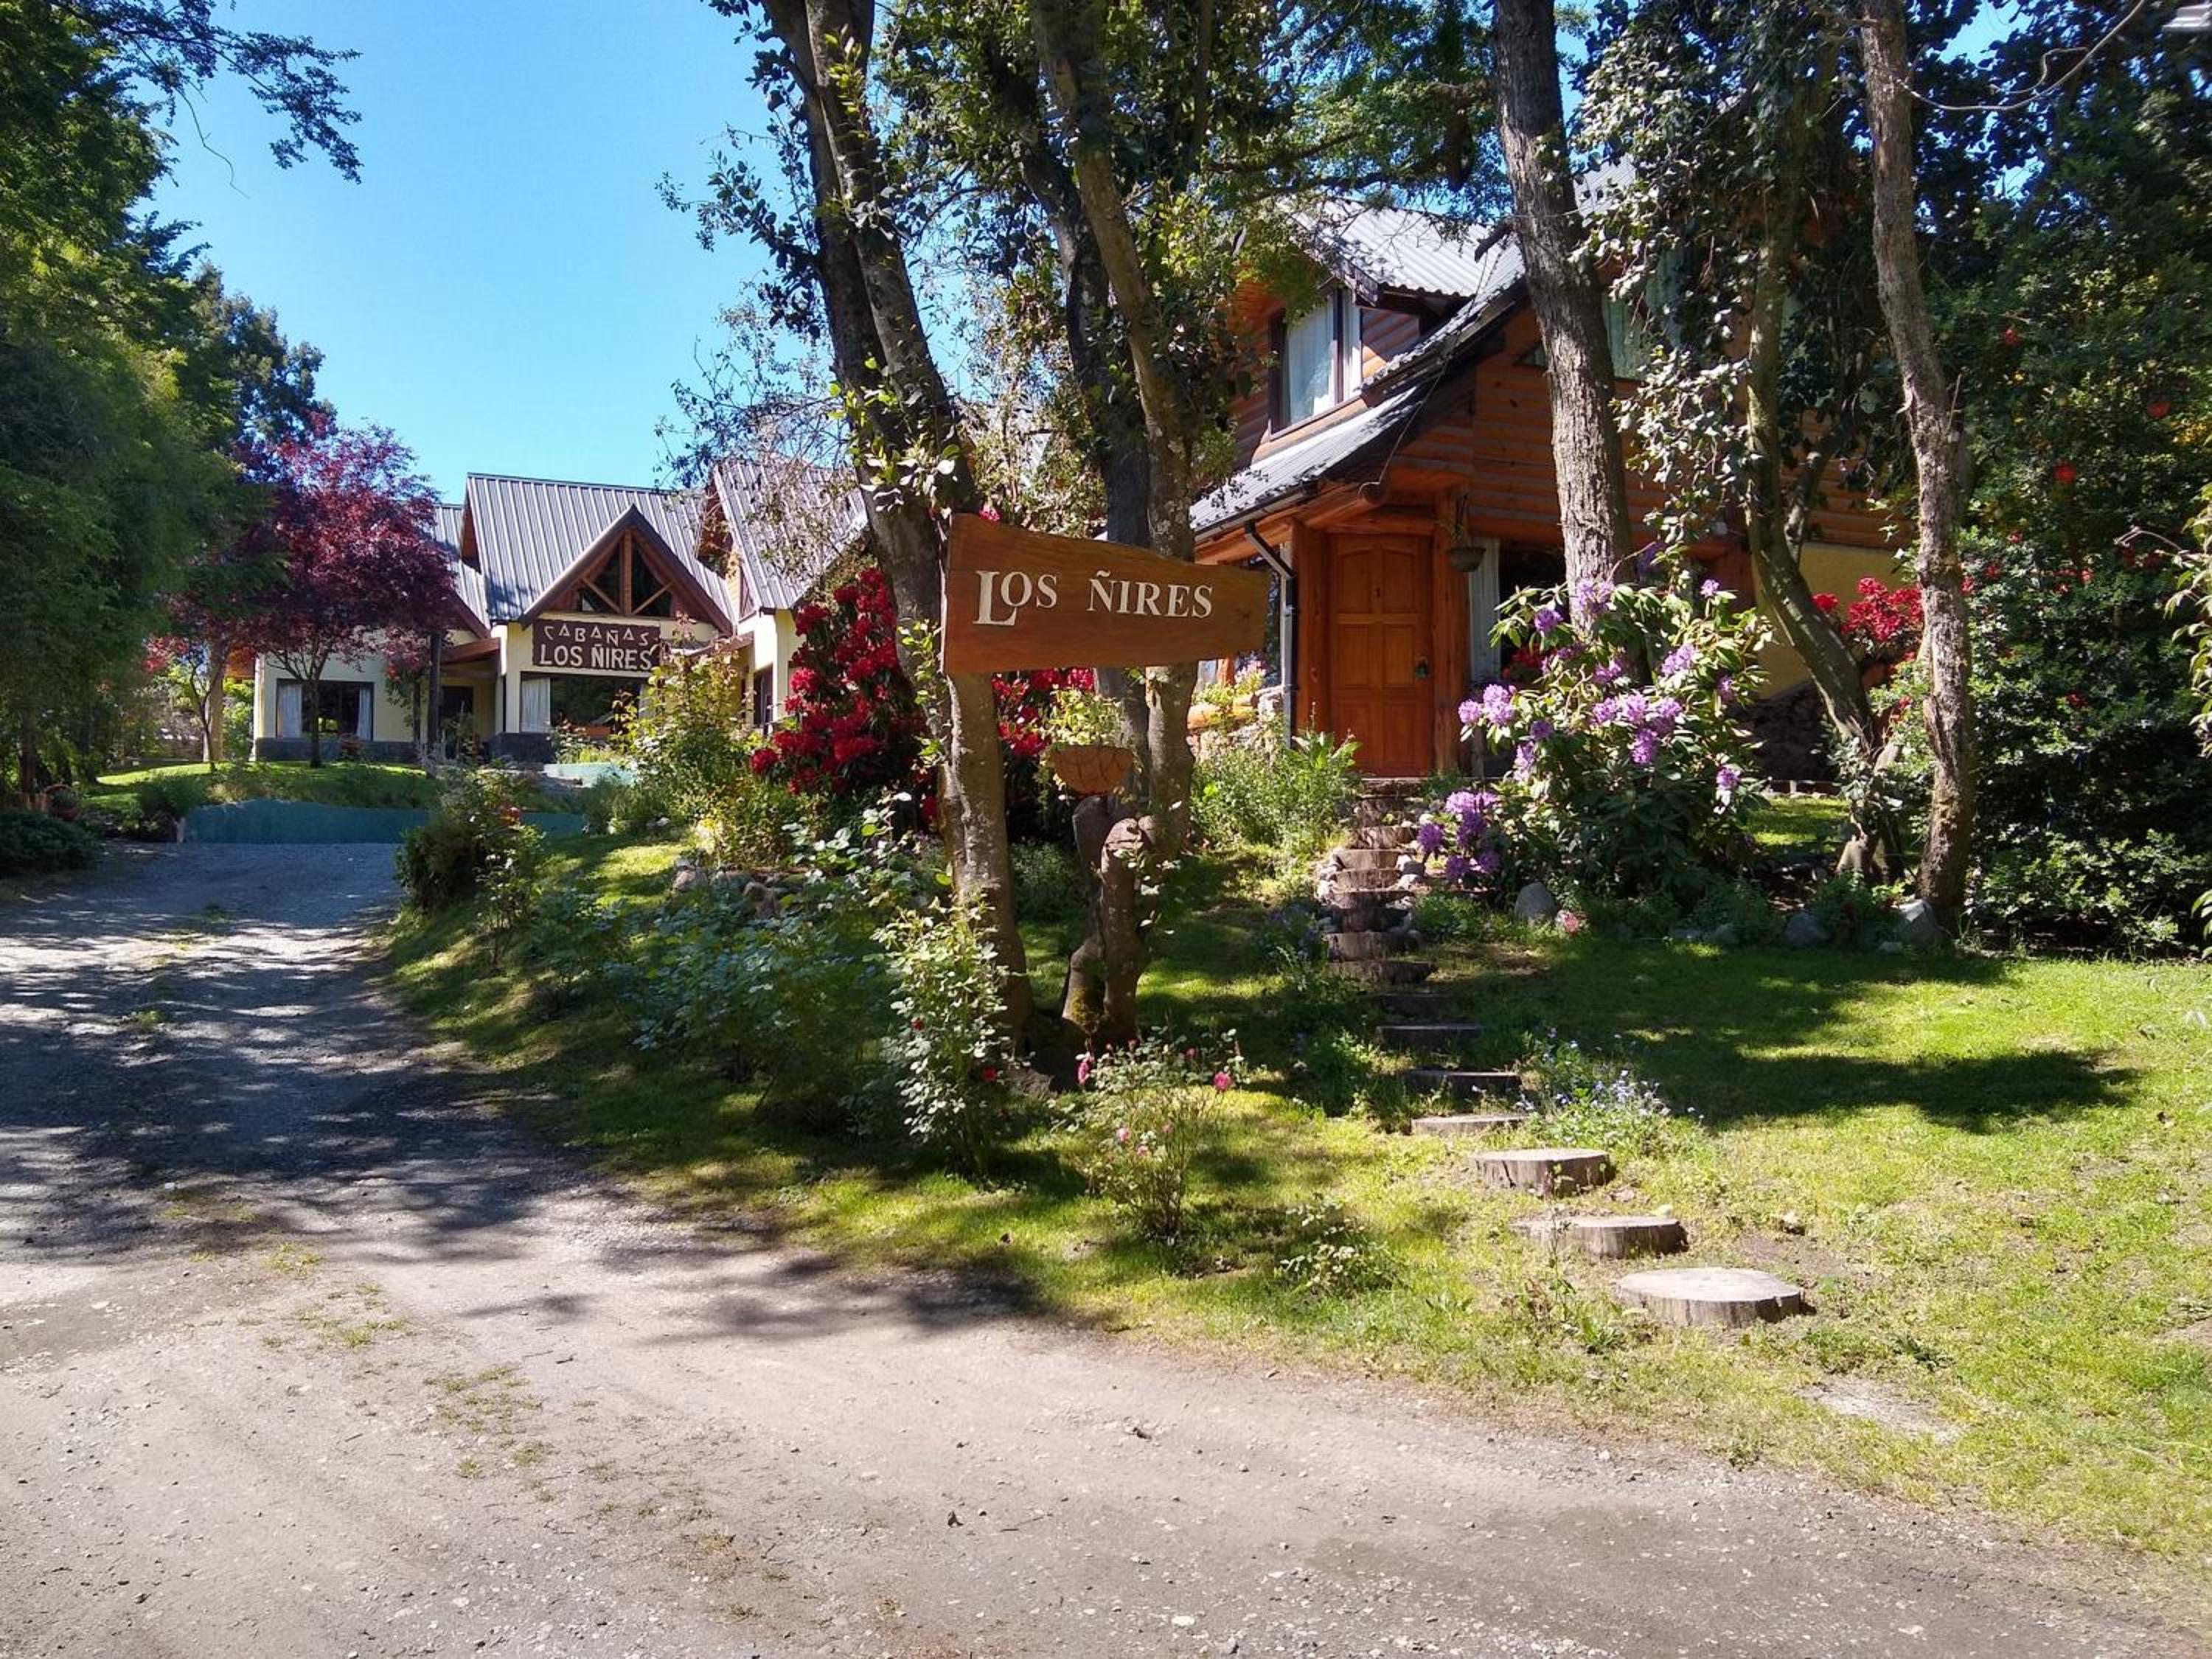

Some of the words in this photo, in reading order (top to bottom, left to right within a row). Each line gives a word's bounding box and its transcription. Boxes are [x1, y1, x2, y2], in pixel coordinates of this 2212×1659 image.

[973, 570, 1057, 626] LOS
[1086, 570, 1213, 619] ÑIRES
[544, 624, 649, 647] CABAÑAS
[540, 644, 582, 667] LOS
[591, 643, 657, 670] ÑIRES
